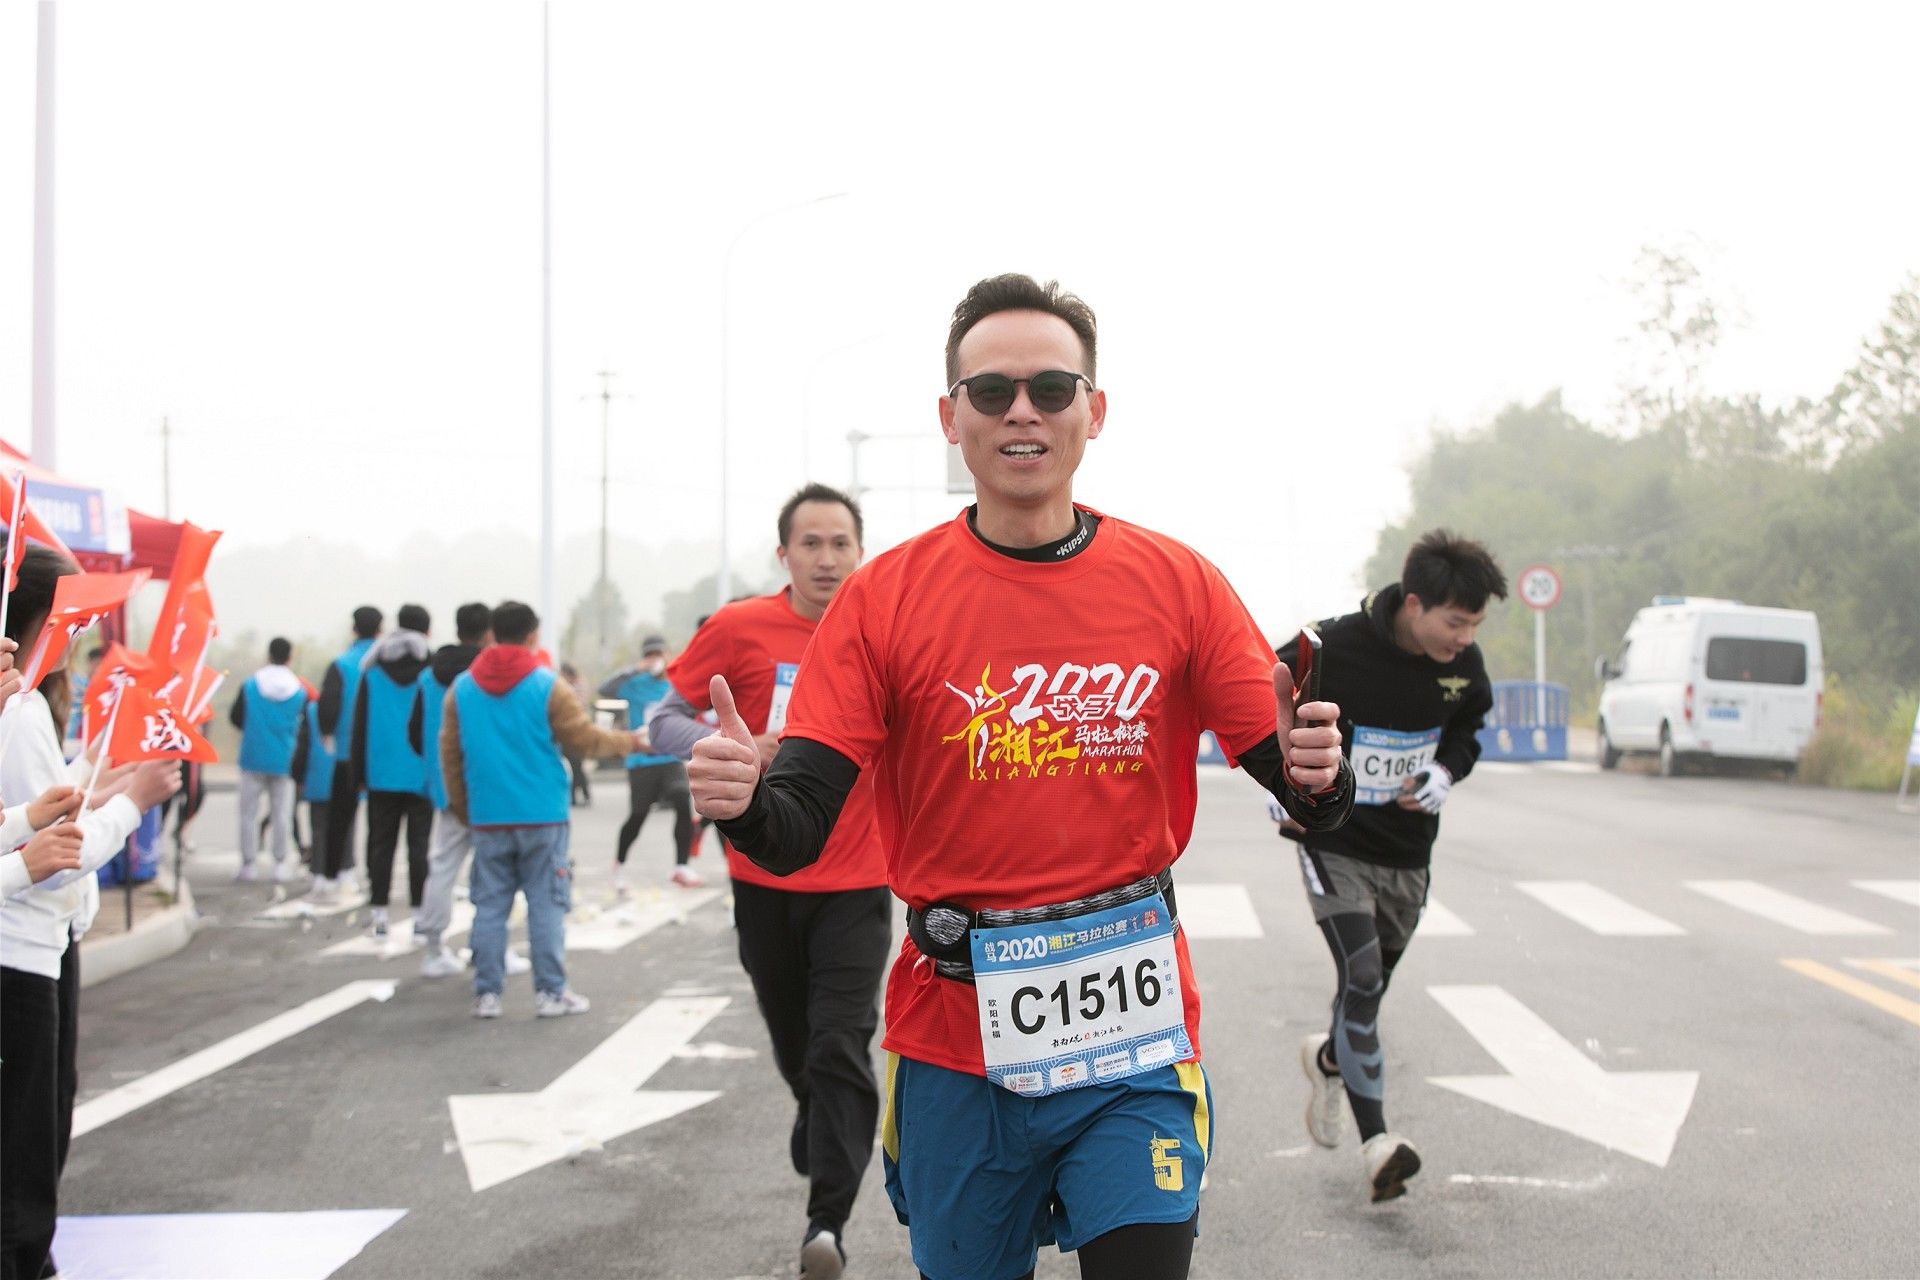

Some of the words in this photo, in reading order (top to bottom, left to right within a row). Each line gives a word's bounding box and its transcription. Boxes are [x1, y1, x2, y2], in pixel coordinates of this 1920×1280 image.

[1529, 577, 1552, 597] 20
[1009, 661, 1160, 726] 2020
[989, 719, 1081, 766] 湘江
[1074, 720, 1150, 745] 马拉松赛
[1081, 744, 1144, 757] MARATHON
[997, 935, 1048, 962] 2020
[1049, 919, 1128, 951] 湘江马拉松赛
[1010, 958, 1162, 1035] C1516
